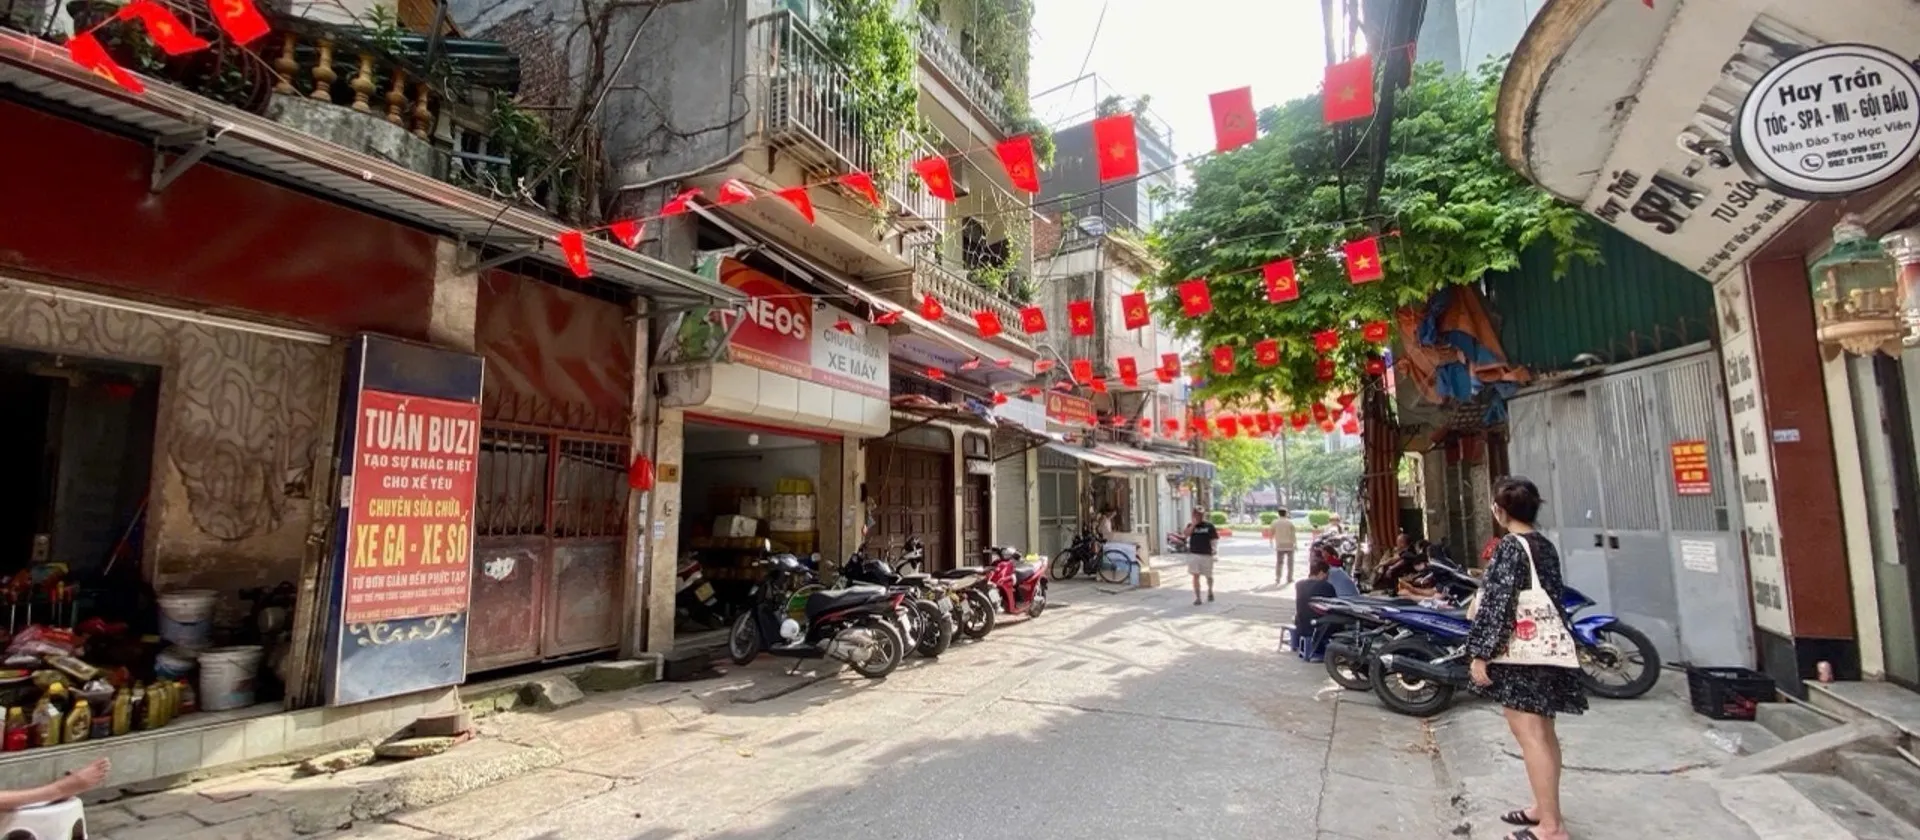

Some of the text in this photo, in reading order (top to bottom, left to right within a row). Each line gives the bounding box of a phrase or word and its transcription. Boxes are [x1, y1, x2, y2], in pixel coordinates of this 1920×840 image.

[1778, 65, 1882, 107] Huy Trần
[1764, 111, 1788, 137] TÓC
[1797, 107, 1823, 130] SPA
[1858, 92, 1881, 122] GỘI
[1832, 131, 1855, 145] Tạo
[1857, 124, 1882, 139] Học
[1884, 119, 1912, 133] Viên
[1594, 197, 1627, 224] Huy
[1631, 171, 1708, 236] SPA
[828, 351, 846, 371] XE
[850, 359, 877, 381] MÁY
[365, 398, 476, 455] TUẤN BUZI
[363, 453, 473, 475] TẠO SỰ KHÁC BIỆT
[382, 475, 409, 489] CHO
[430, 477, 453, 490] YÊU
[368, 493, 461, 518] CHUYÊN SỬA CHỮA
[353, 523, 381, 568] XE
[382, 523, 406, 567] GA
[420, 523, 443, 565] XE
[445, 510, 469, 564] SỐ
